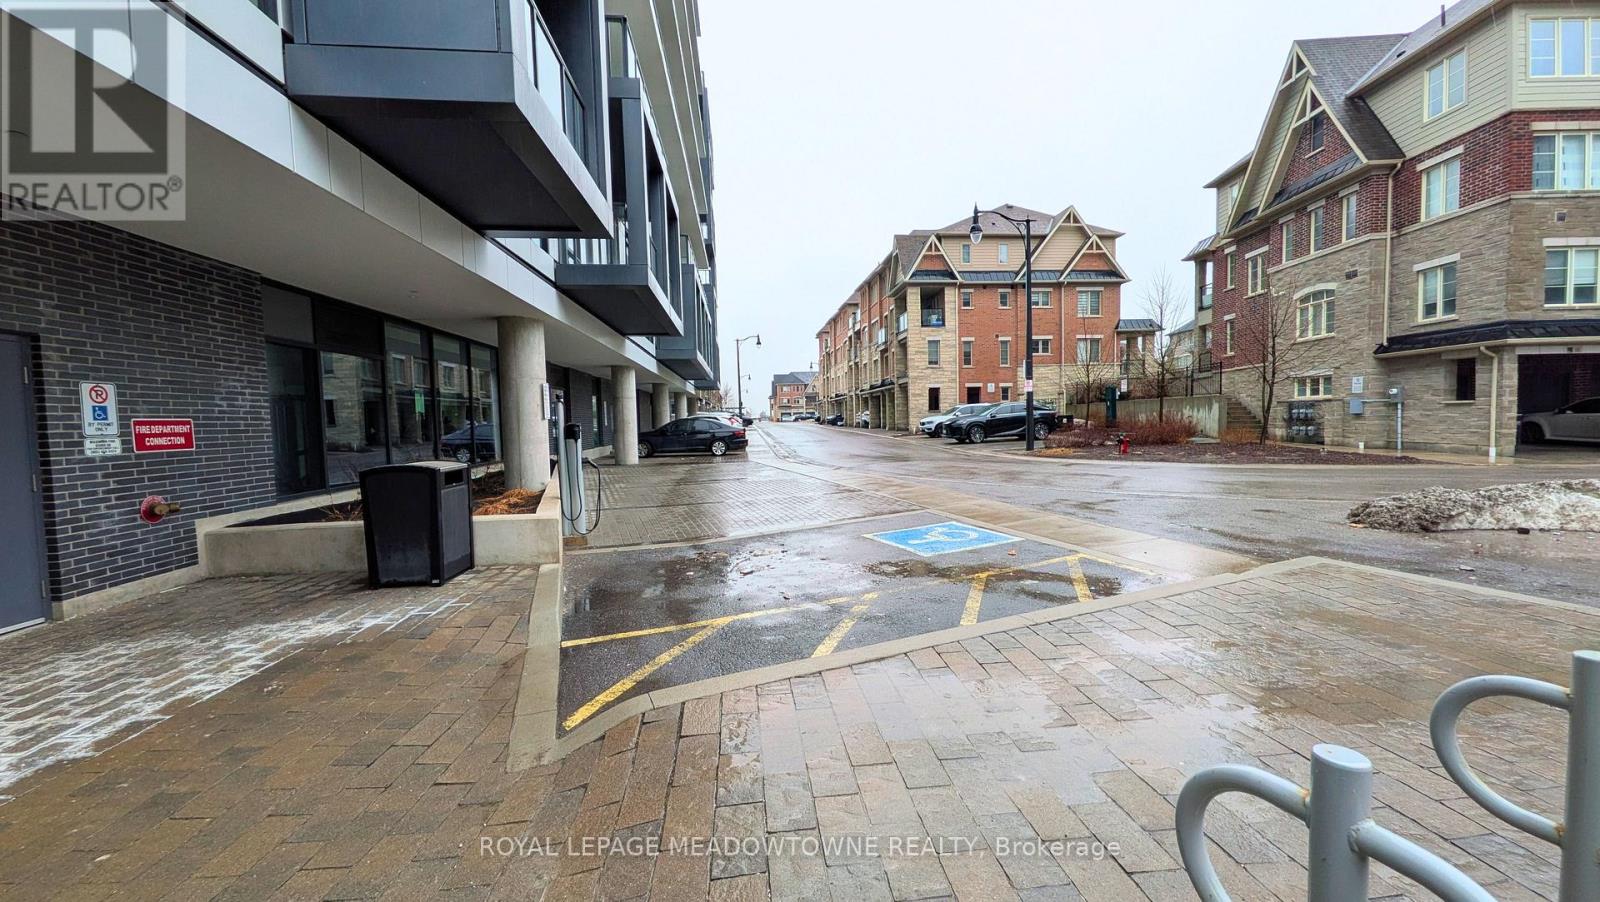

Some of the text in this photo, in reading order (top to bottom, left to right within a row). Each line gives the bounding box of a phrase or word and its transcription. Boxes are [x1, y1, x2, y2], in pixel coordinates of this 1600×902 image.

[135, 424, 191, 434] FIRE DEPARTMENT
[145, 436, 185, 446] CONNECTION
